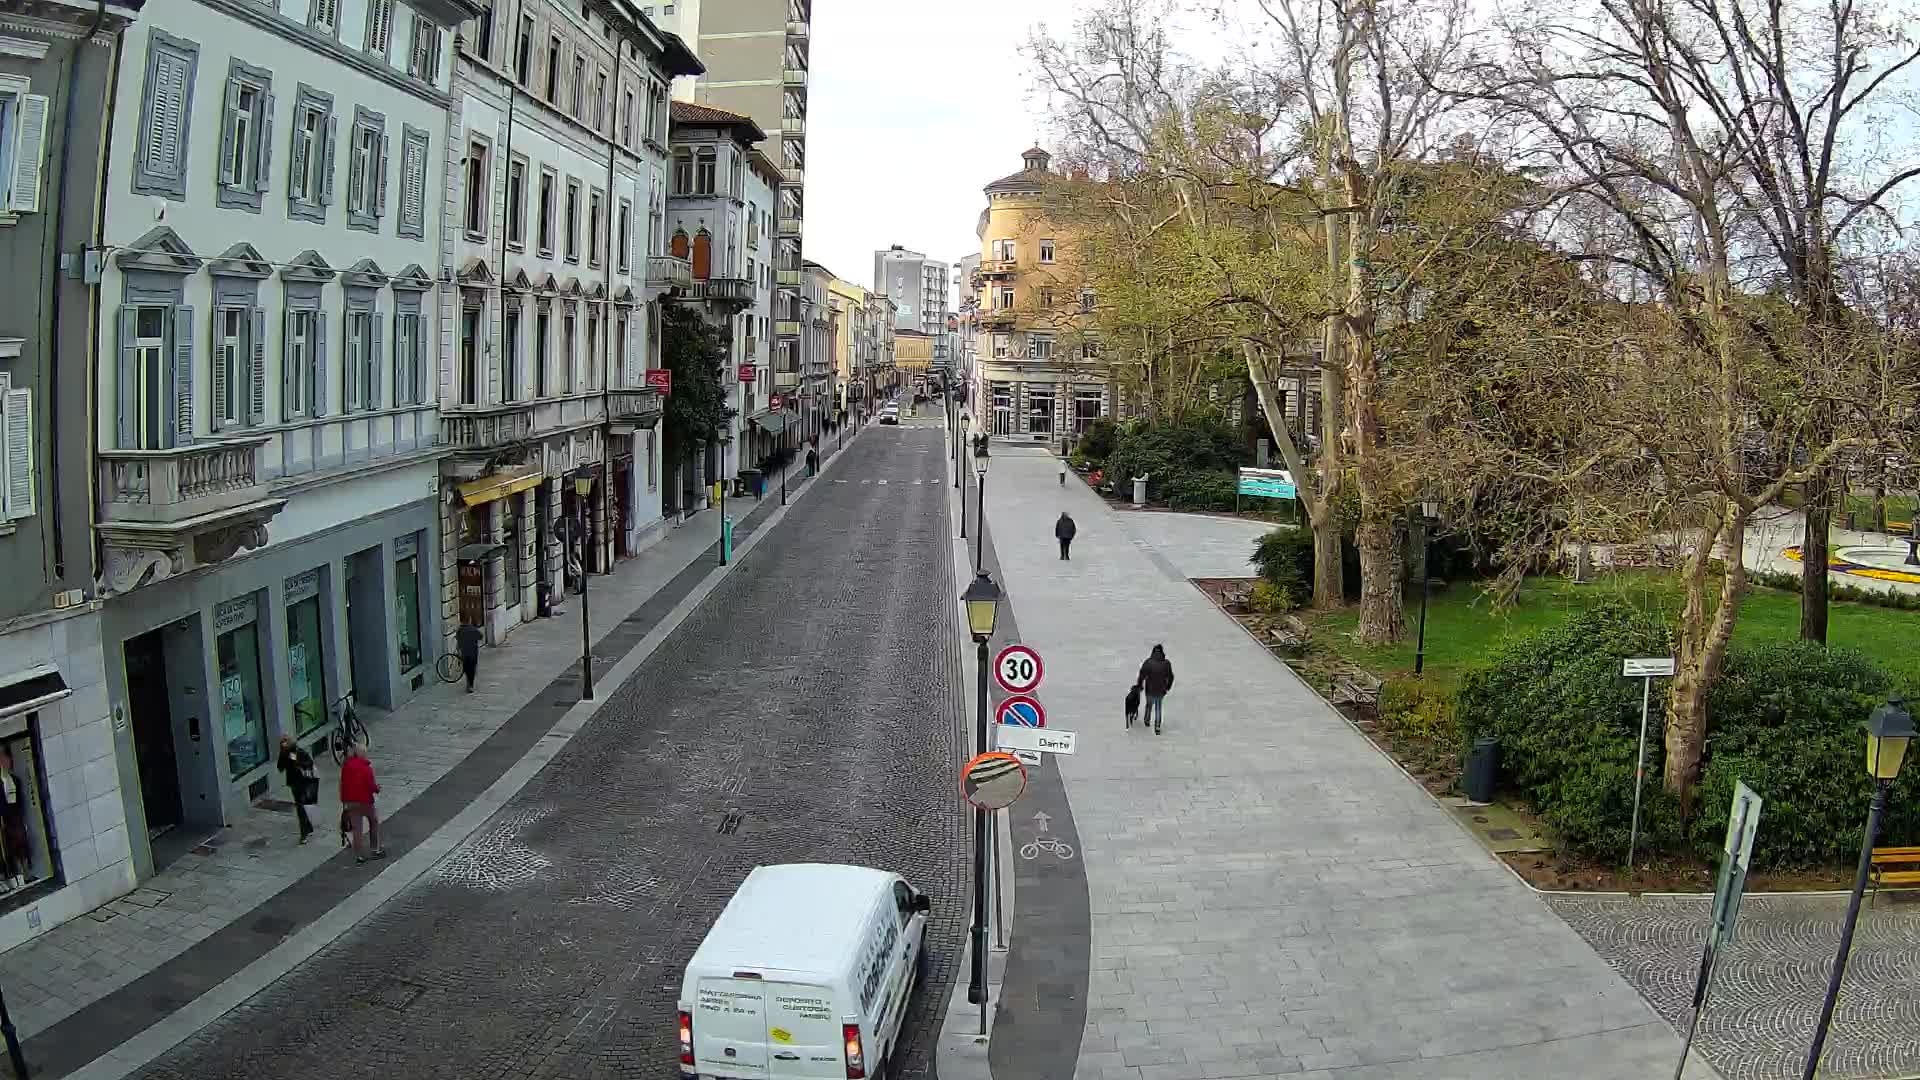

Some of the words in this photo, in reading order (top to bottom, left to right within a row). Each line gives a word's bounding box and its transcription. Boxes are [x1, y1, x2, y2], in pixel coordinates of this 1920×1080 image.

[1006, 658, 1033, 680] 30
[1039, 738, 1070, 749] Dante
[776, 996, 822, 1005] DEPOSITO
